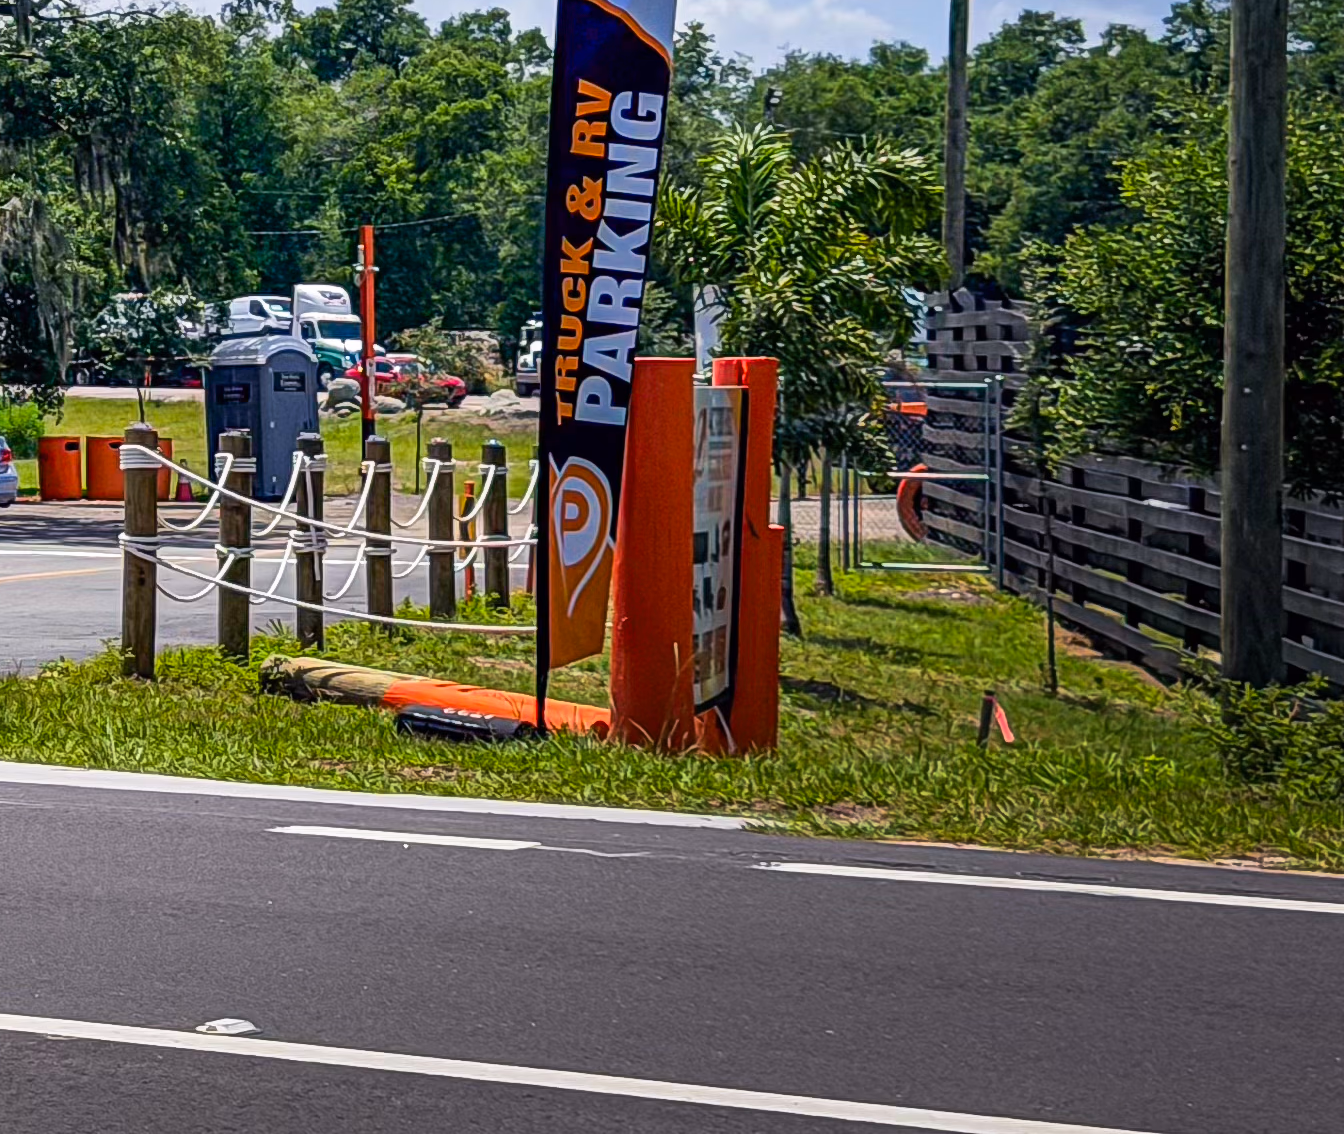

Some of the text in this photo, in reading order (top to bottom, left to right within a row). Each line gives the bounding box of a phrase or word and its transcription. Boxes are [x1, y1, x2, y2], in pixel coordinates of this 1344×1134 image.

[555, 78, 613, 426] TRUCK & RV
[574, 90, 664, 427] PARKING
